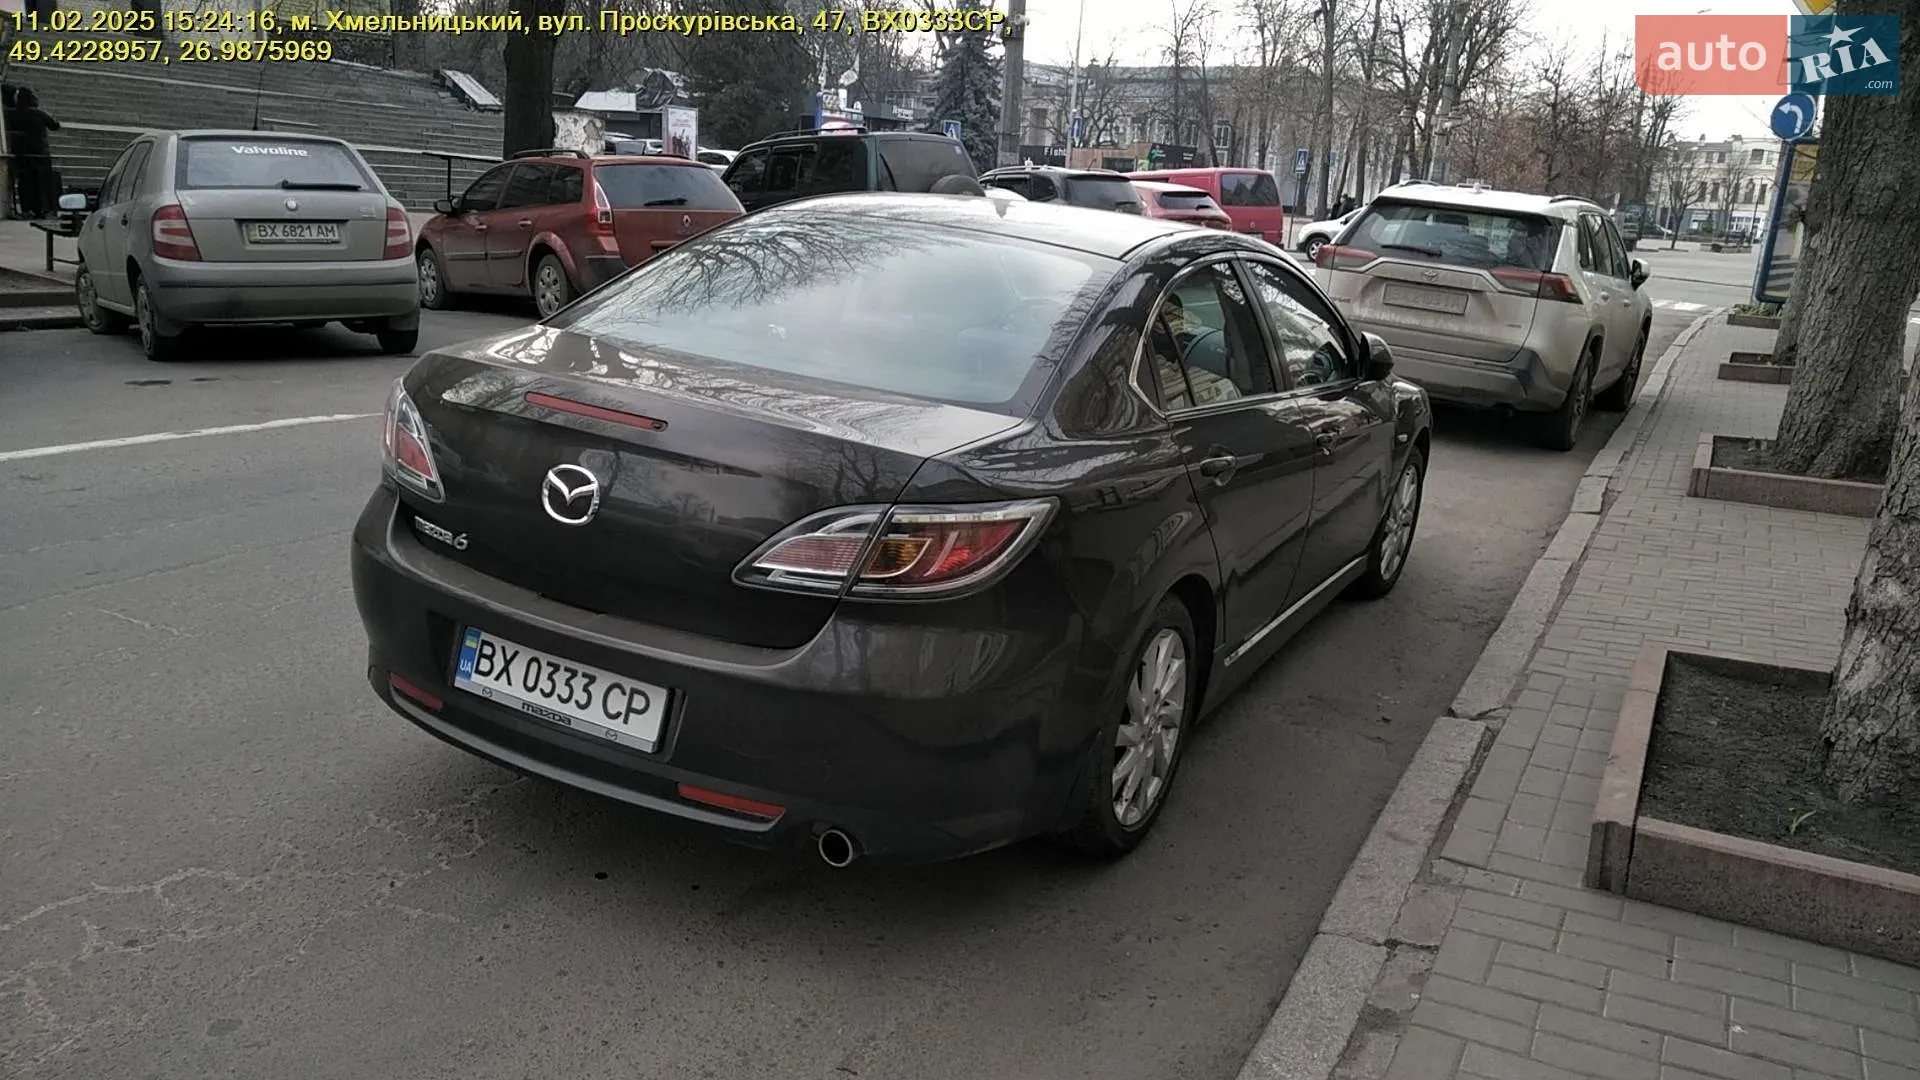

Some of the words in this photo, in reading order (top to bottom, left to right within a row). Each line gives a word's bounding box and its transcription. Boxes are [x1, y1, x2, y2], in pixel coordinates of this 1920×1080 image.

[231, 146, 308, 157] Valvoline
[282, 224, 313, 238] 6821
[453, 533, 469, 550] 6
[459, 659, 472, 673] UA
[474, 639, 520, 687] BX
[522, 656, 597, 711] 0333
[602, 682, 650, 725] CP
